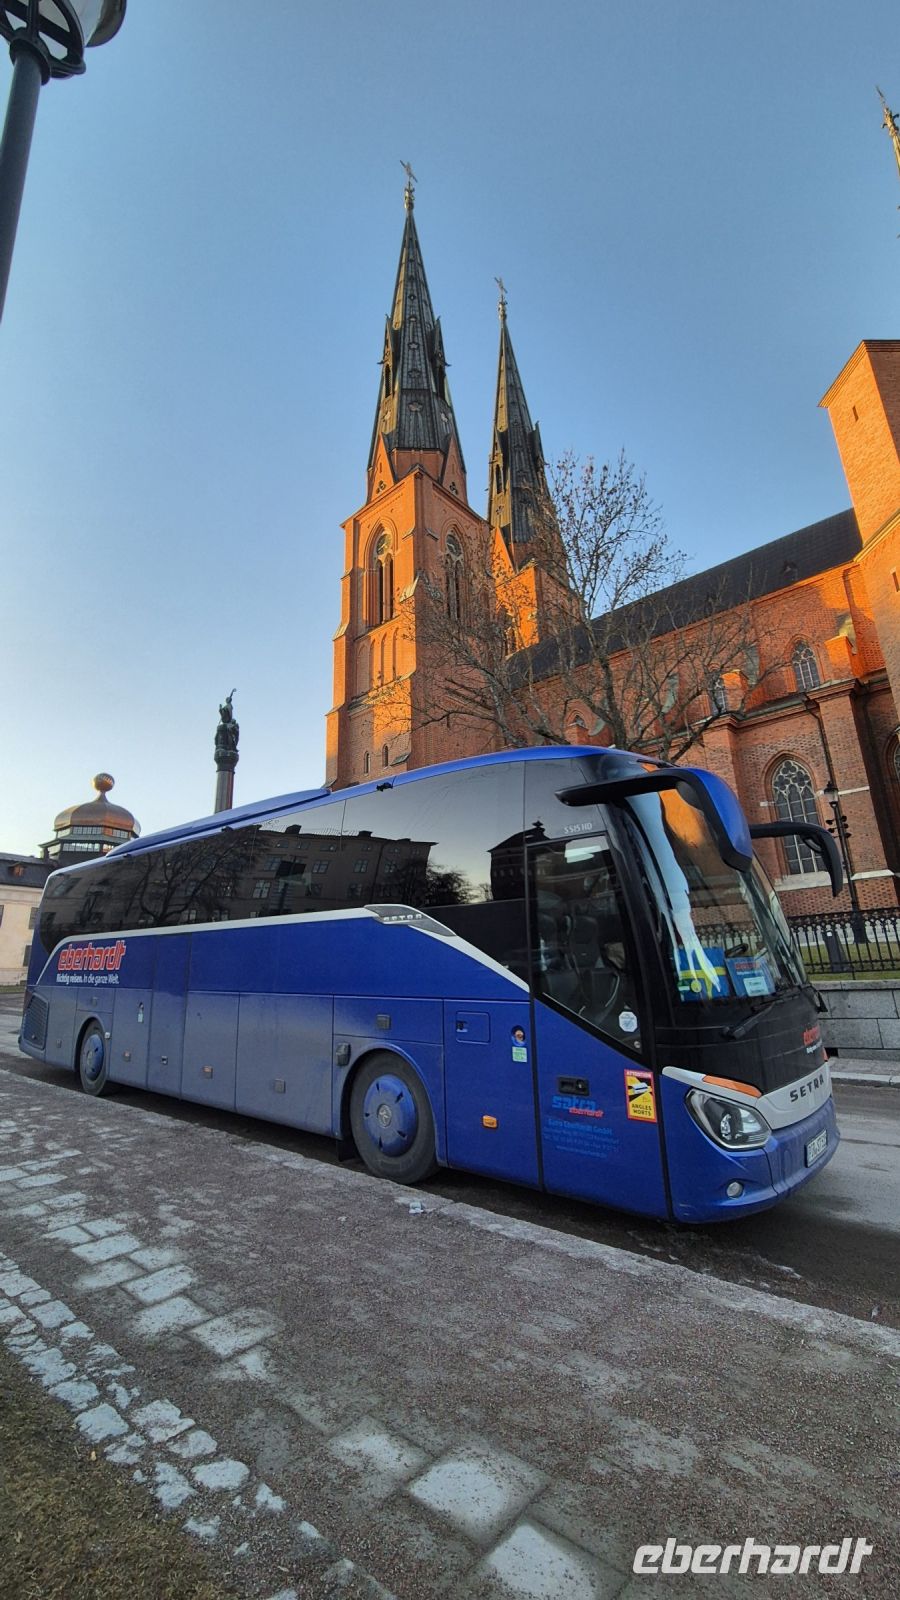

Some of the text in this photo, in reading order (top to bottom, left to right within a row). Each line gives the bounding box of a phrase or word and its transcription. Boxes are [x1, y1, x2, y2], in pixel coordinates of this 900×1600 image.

[58, 940, 126, 970] eberhardt
[789, 1074, 825, 1102] SETRA
[631, 1103, 652, 1111] ANGLES
[633, 1108, 652, 1117] MORTS
